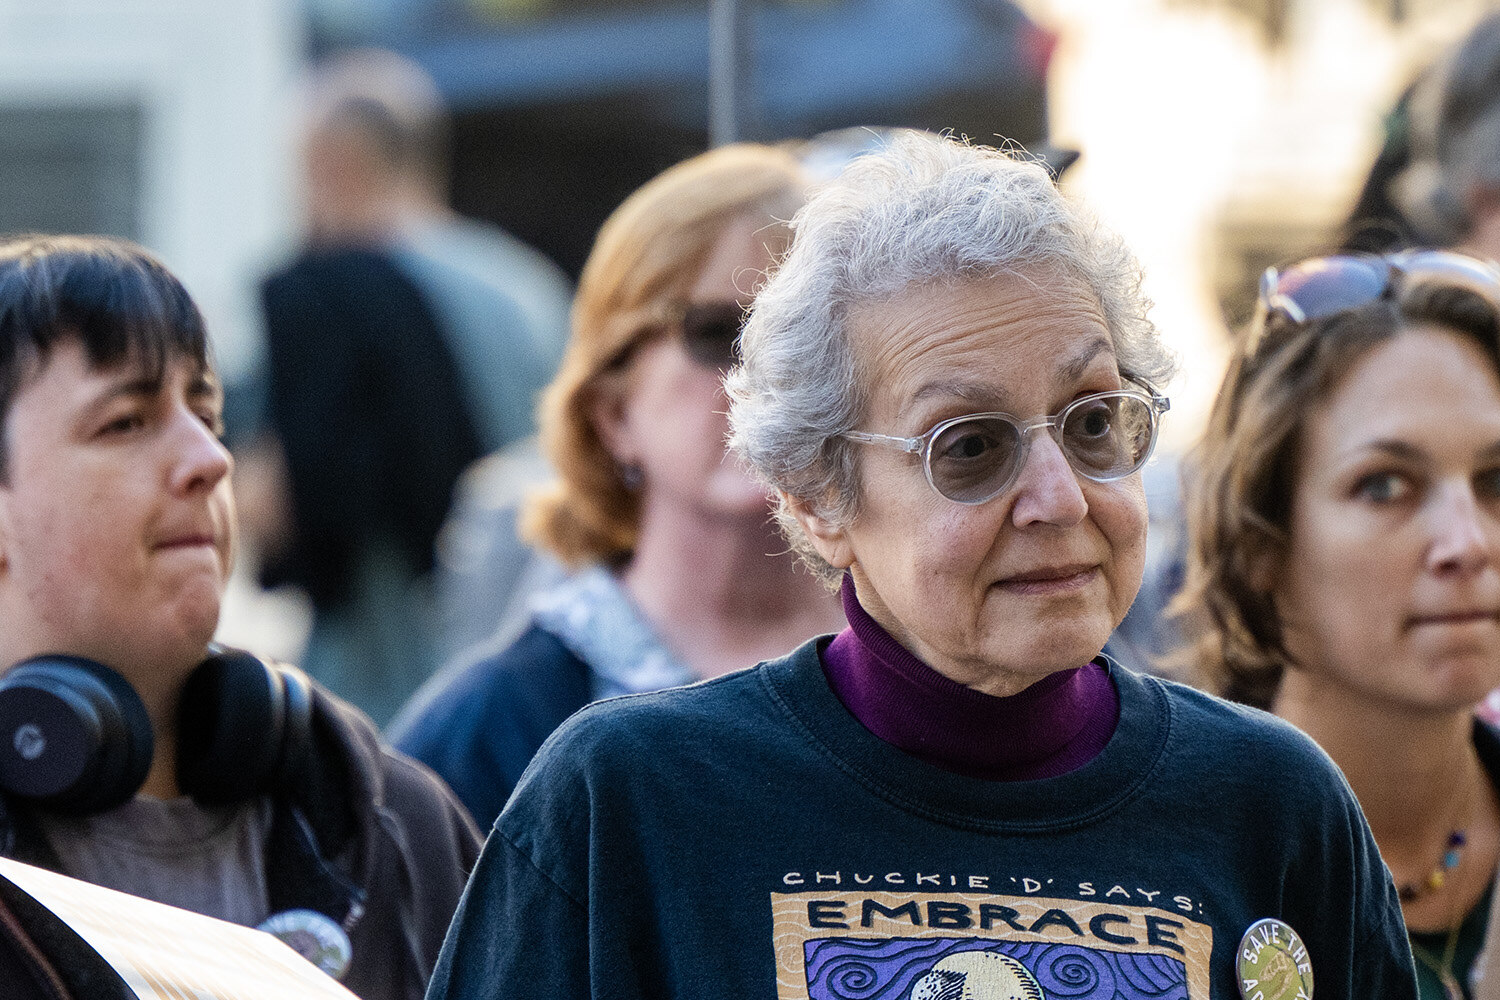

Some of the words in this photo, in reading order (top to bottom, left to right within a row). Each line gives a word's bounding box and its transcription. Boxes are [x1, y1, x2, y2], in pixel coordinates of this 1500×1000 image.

[782, 871, 990, 889] CHUCKIE
[1078, 882, 1204, 915] SAYS:
[806, 899, 1189, 953] EMBRACE
[1243, 924, 1280, 964] SAVE
[1288, 933, 1311, 975] THE
